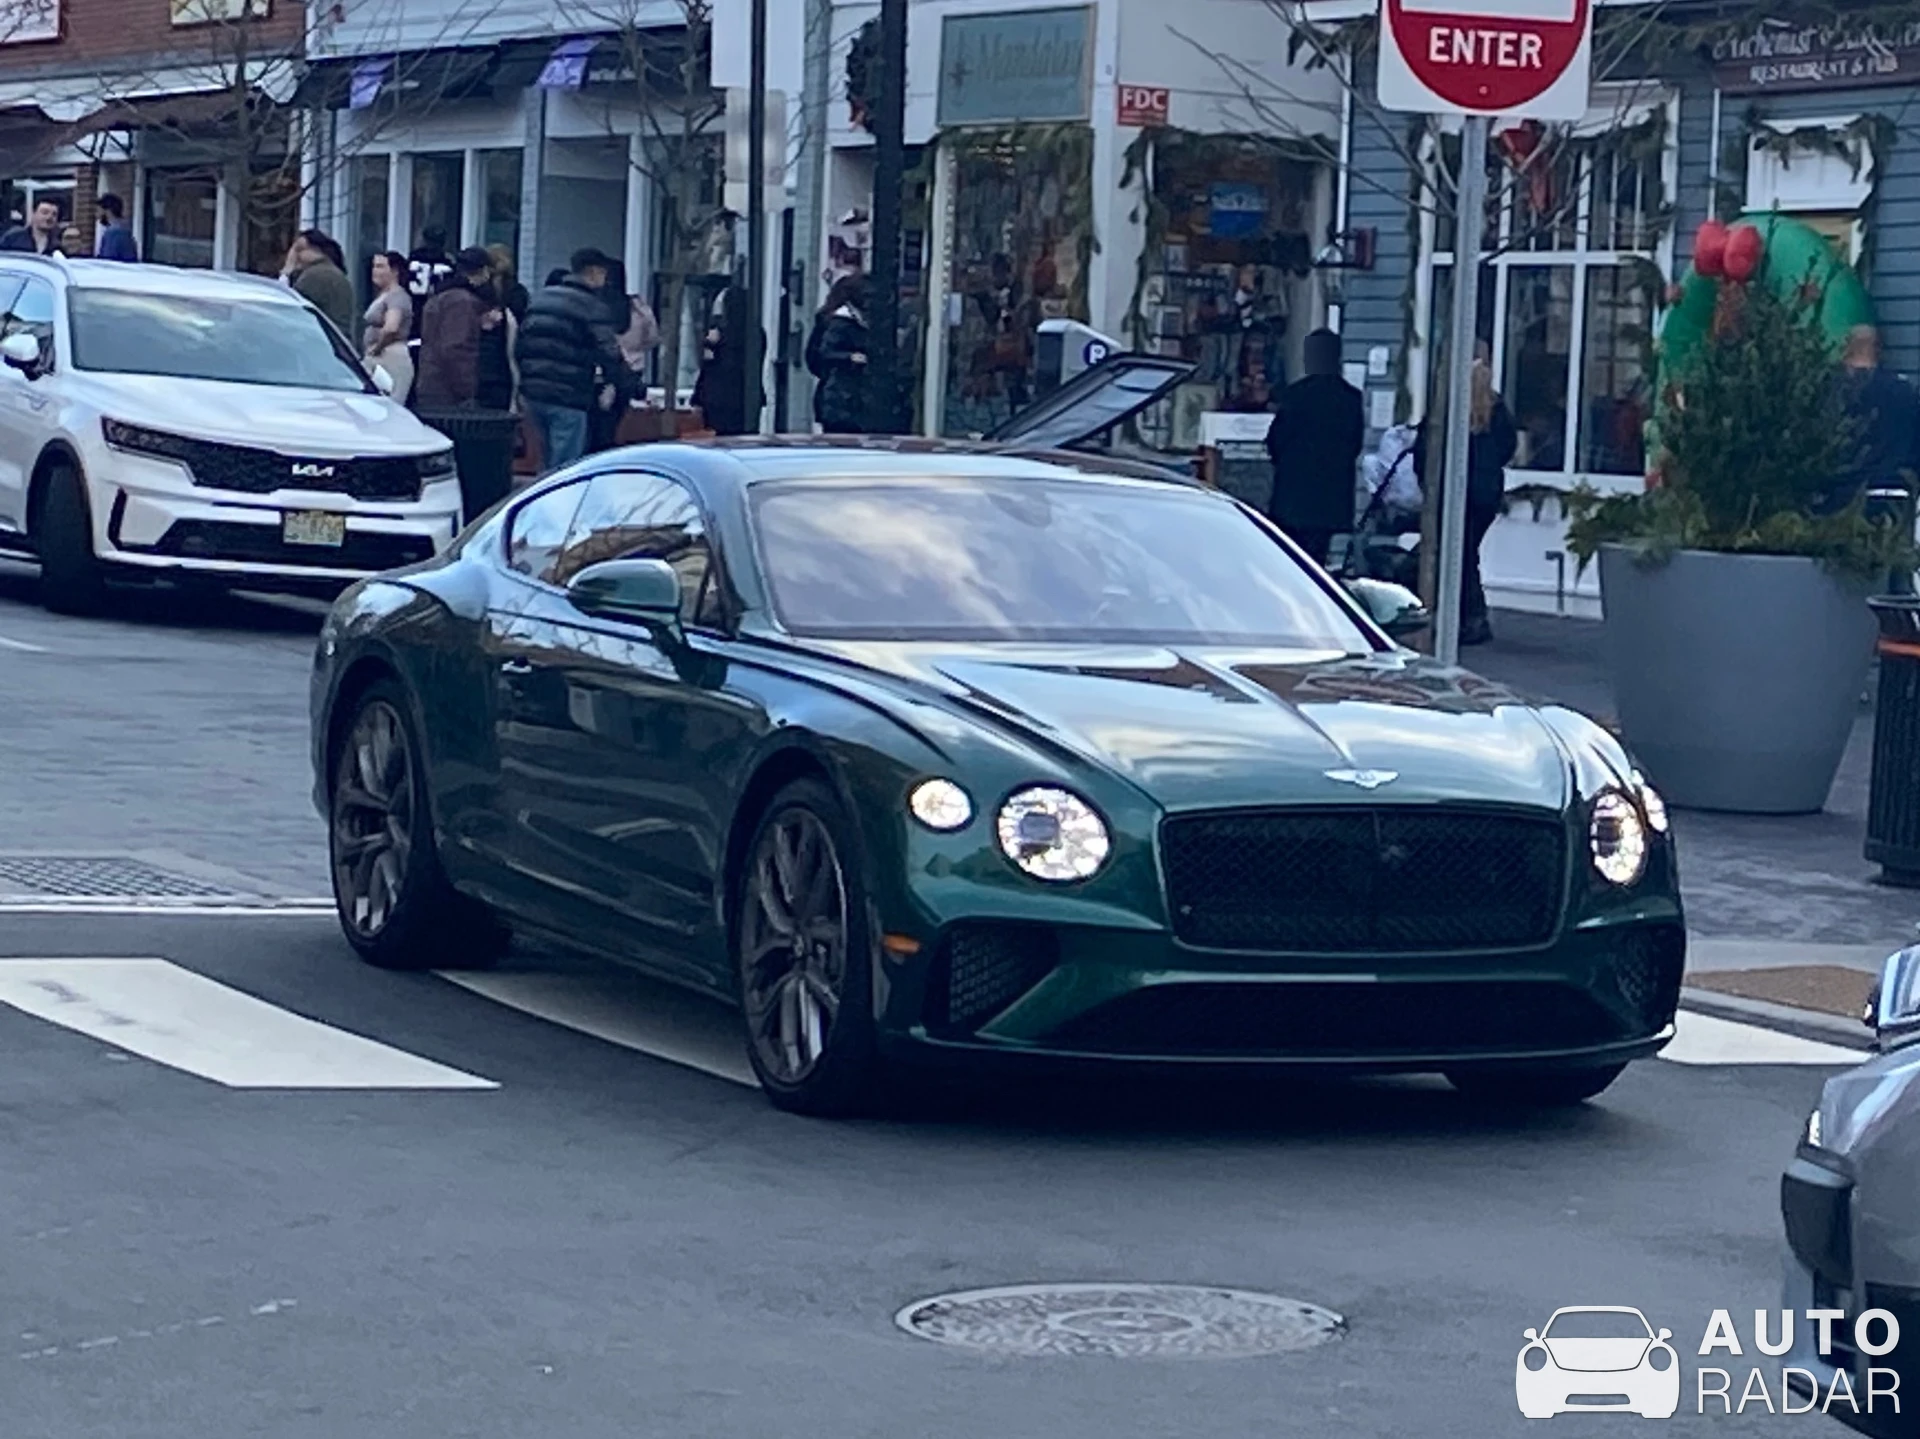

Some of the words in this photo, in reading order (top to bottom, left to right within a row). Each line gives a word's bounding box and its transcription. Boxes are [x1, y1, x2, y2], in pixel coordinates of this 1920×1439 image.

[1428, 26, 1543, 69] ENTER
[1121, 87, 1167, 111] FDC
[1089, 344, 1106, 364] P
